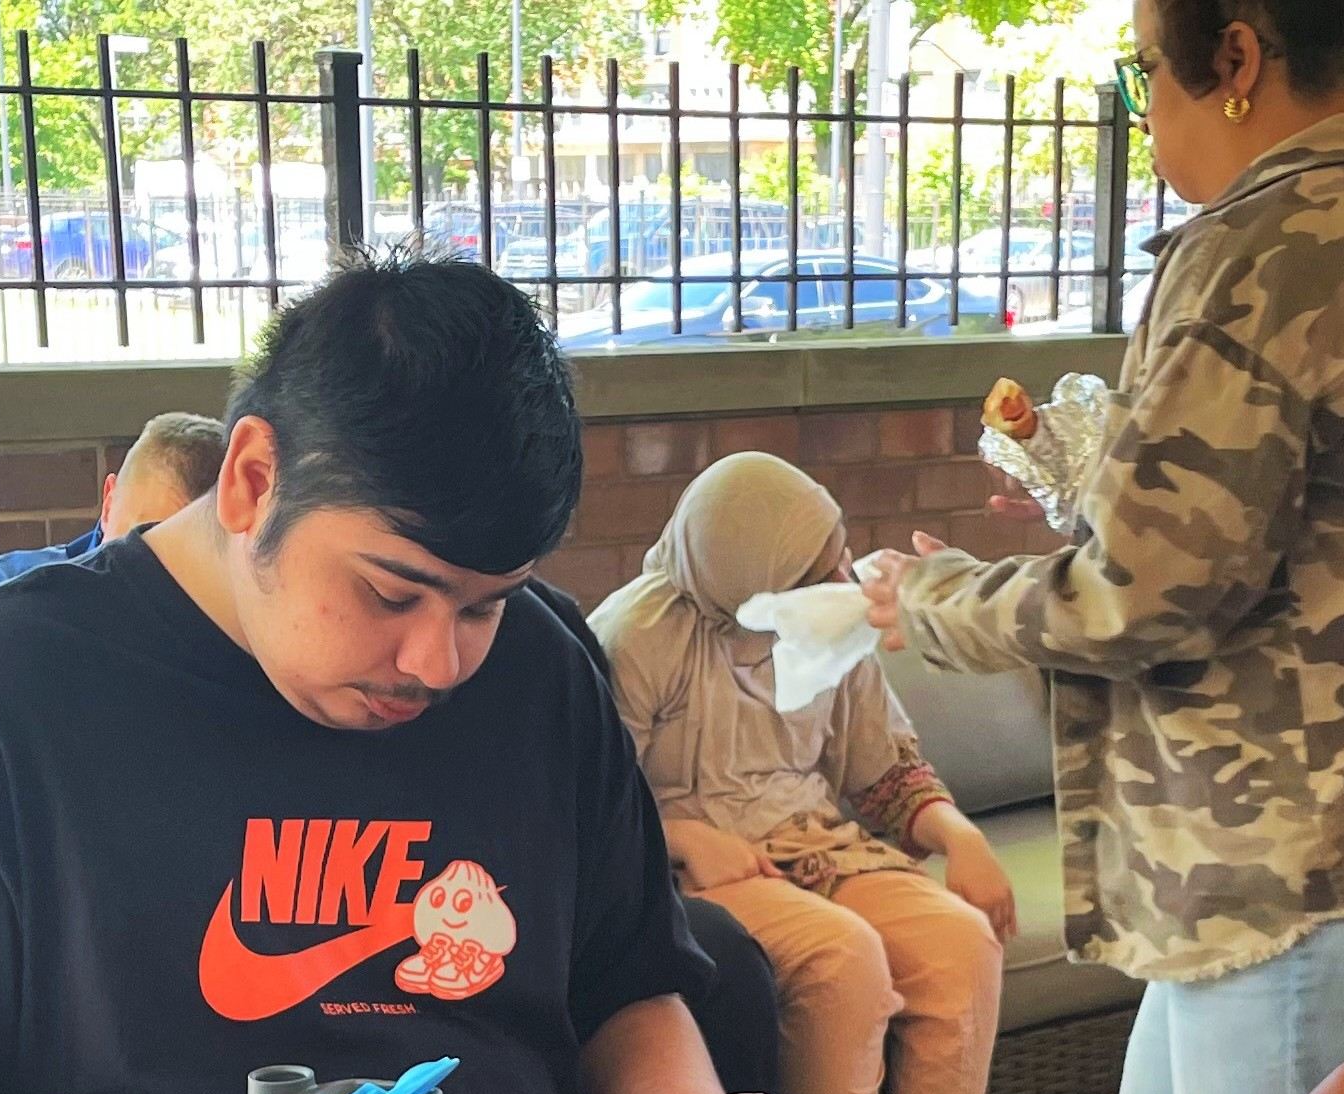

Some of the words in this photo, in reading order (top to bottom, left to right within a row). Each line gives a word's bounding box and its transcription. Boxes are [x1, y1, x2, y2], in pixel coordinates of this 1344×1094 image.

[240, 818, 432, 926] NIKE
[320, 1002, 370, 1016] SERVED
[372, 1002, 417, 1015] FRESH
